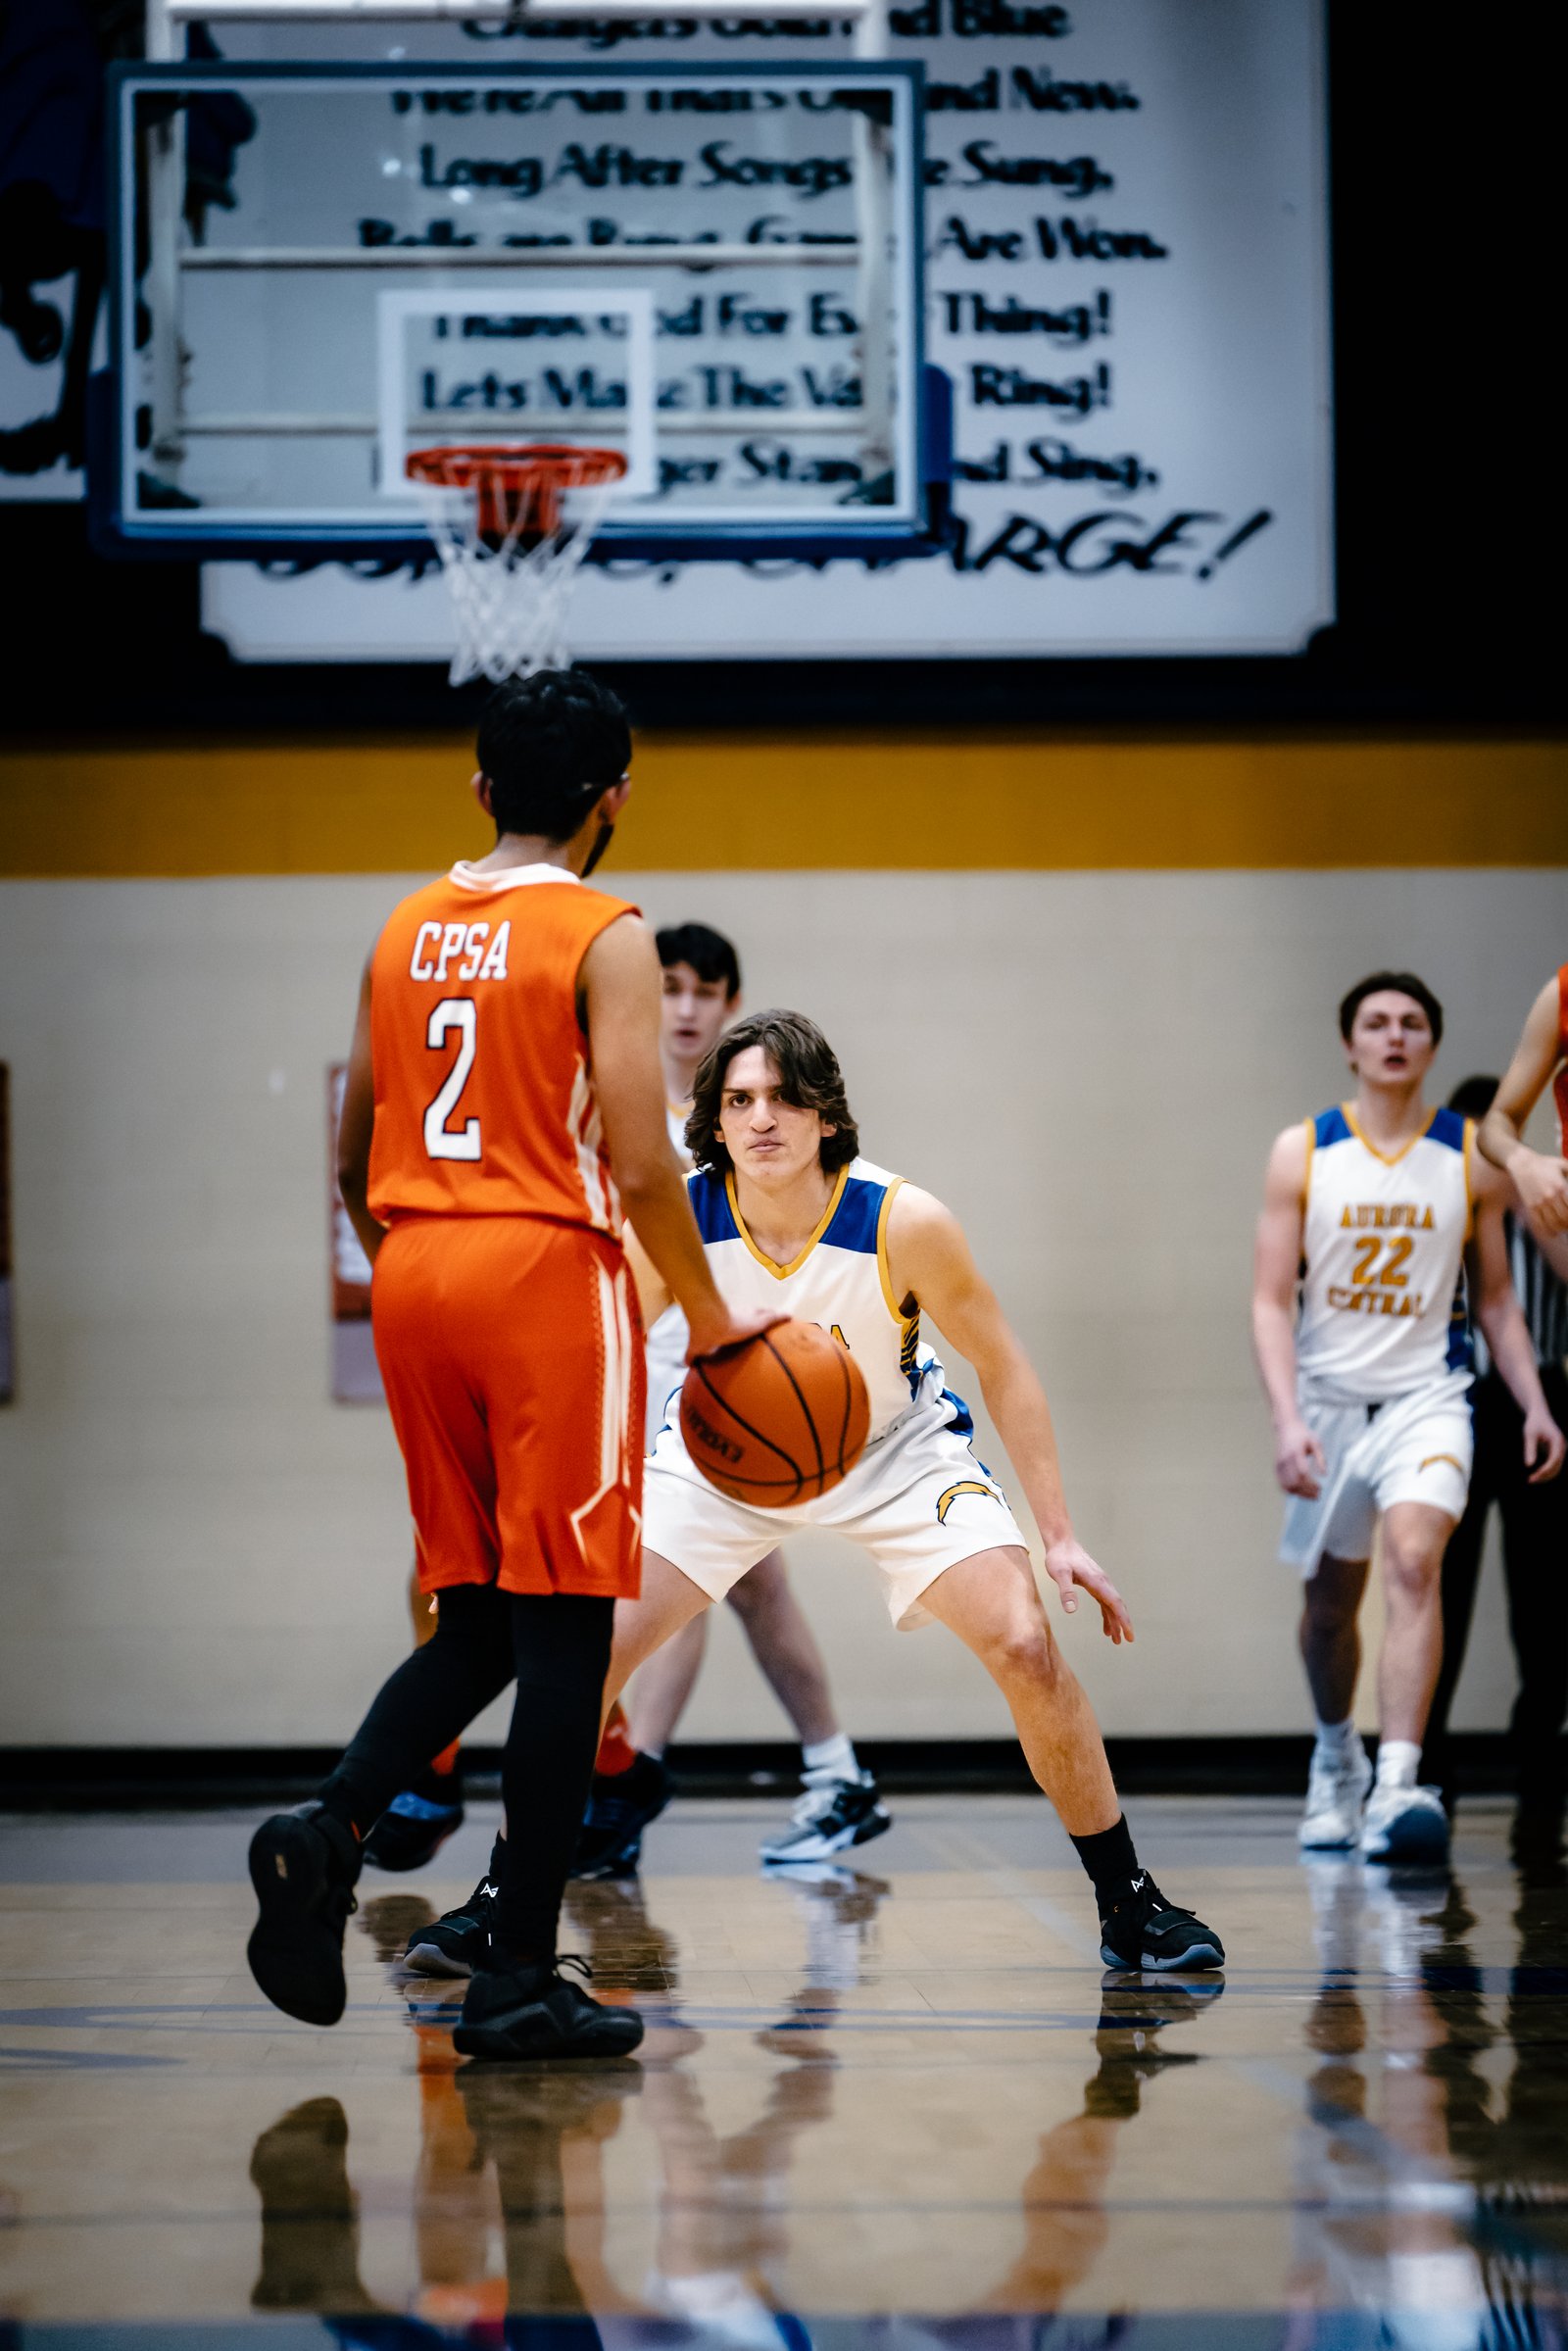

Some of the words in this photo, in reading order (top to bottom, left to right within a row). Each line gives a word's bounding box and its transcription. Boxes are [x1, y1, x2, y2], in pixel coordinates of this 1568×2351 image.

[888, 0, 941, 37] nd
[924, 67, 999, 111] nd
[419, 142, 543, 199] Long
[550, 142, 685, 187] After
[697, 139, 854, 198] Songs
[929, 217, 1022, 260] Are
[717, 292, 790, 336] For
[936, 287, 1111, 349] Thing!
[422, 367, 528, 410] Lets
[541, 366, 688, 409] Mae
[694, 365, 791, 409] The
[969, 360, 1111, 422] Ring!
[950, 441, 1009, 483] nd
[411, 919, 512, 983] CPSA
[423, 997, 482, 1161] 2
[1339, 1202, 1437, 1230] AURORA
[1351, 1235, 1414, 1287] 22
